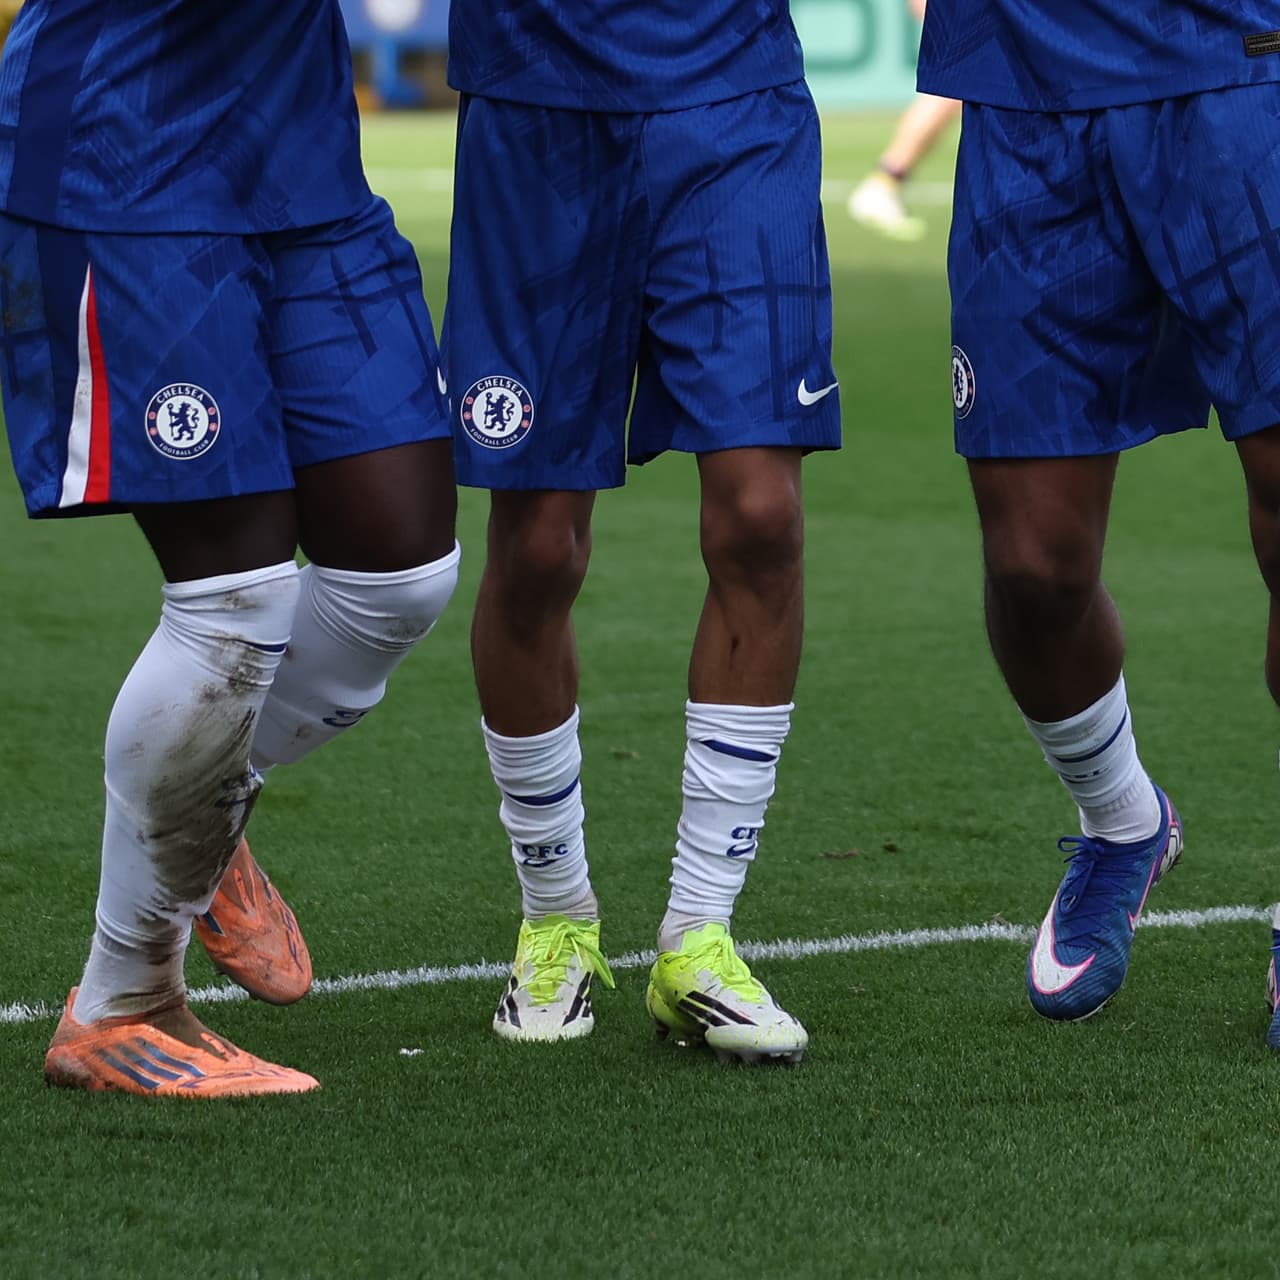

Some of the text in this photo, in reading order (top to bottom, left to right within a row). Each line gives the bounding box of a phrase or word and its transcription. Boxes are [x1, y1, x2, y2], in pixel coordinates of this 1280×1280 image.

[156, 386, 204, 404] CHELSEA
[477, 378, 523, 397] CHELSEA
[522, 843, 568, 858] CFC
